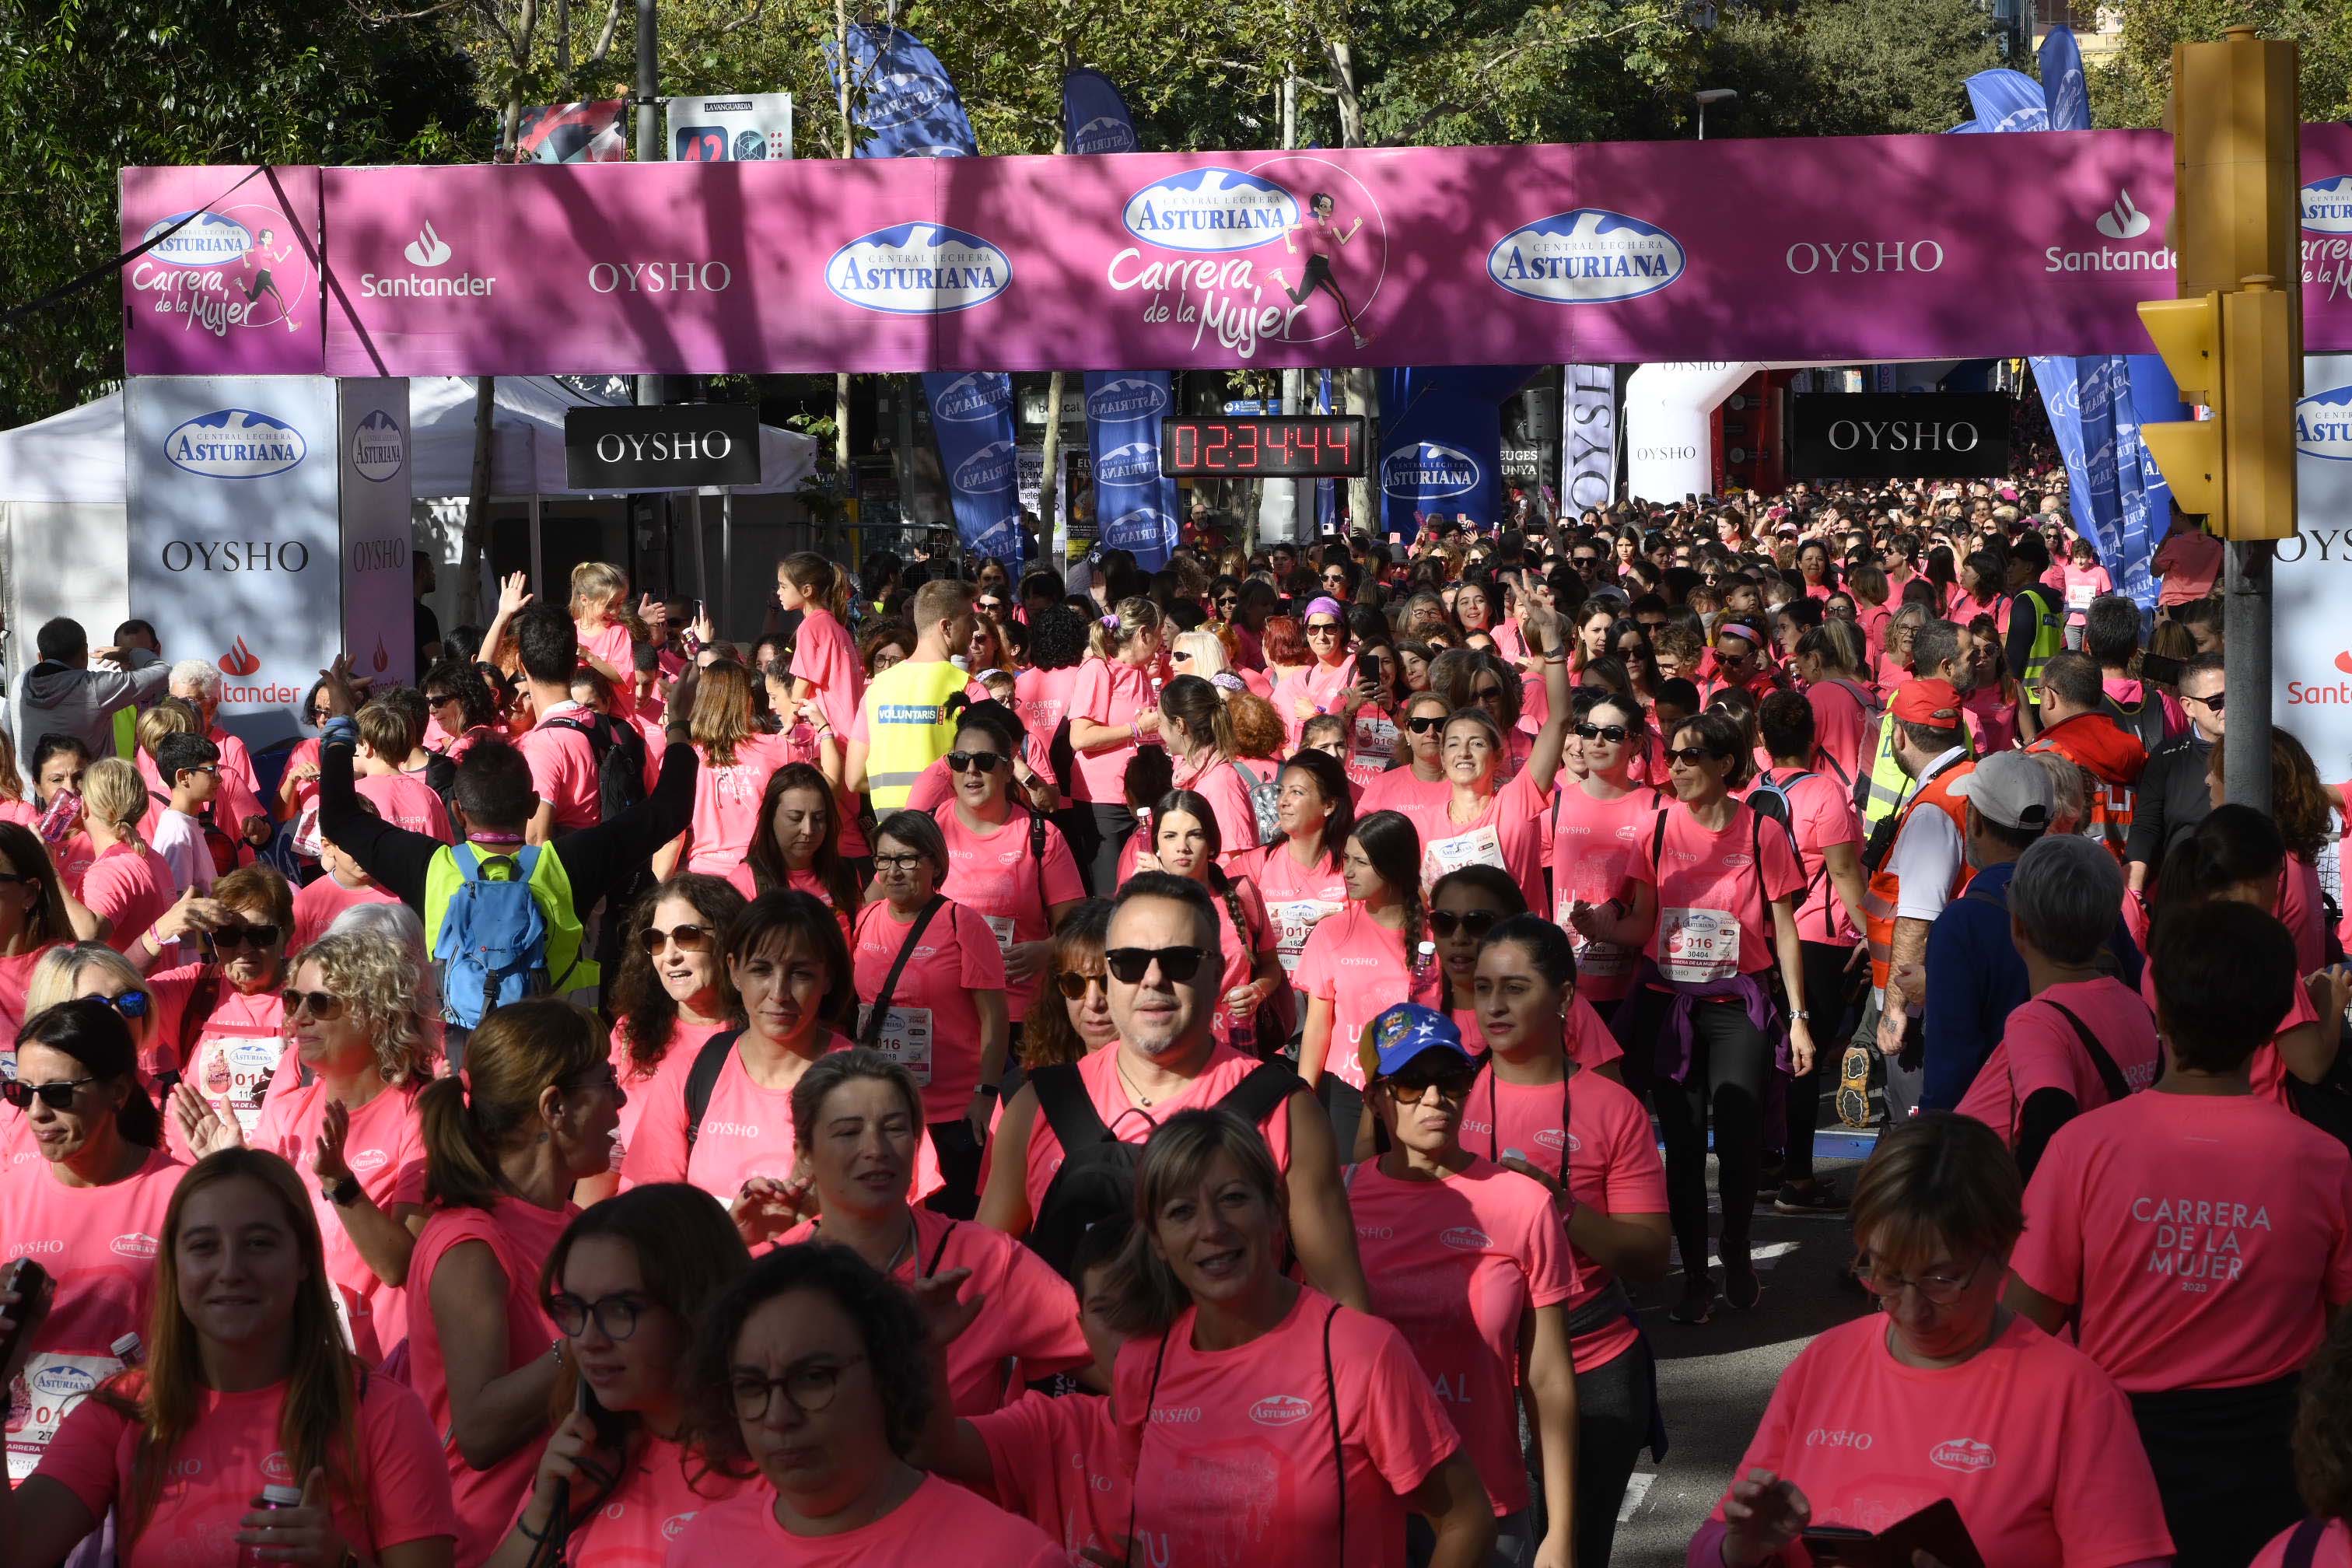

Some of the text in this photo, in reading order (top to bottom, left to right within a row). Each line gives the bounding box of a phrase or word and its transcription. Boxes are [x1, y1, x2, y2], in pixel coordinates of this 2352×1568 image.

[1225, 195, 1281, 205] LECHERA
[1136, 200, 1286, 231] ASTURIANA
[1533, 240, 1664, 252] CENTRAL LECHERA
[869, 253, 992, 263] CENTRAL LECHERA
[1502, 245, 1671, 281] ASTURIANA
[1786, 240, 1944, 275] OYSHO
[2045, 247, 2177, 272] Santande
[132, 261, 223, 292] Carrera
[588, 261, 731, 292] OYSHO
[839, 257, 998, 291] ASTURIANA
[1107, 247, 1255, 291] Carrera
[2318, 261, 2332, 284] la
[361, 273, 496, 298] Santander
[155, 289, 259, 337] de la Mujer
[1143, 285, 1308, 359] de la Mujer
[1038, 401, 1081, 414] b.cat
[197, 432, 292, 441] CENTRAL LECHERA
[597, 429, 731, 464] OYSHO
[1174, 425, 1349, 467] 02:34:44
[1570, 363, 1612, 511] OYSH
[1828, 420, 1979, 452] OYSHO
[176, 435, 296, 461] ASTURIANA
[355, 436, 401, 465] ASTURIANA
[1637, 446, 1696, 461] OYSHO
[1019, 471, 1032, 479] que
[1384, 469, 1472, 487] ASTURIANA
[162, 541, 309, 572] OYSHO
[353, 537, 405, 573] OYSHO
[218, 682, 301, 703] tander
[880, 709, 936, 720] VOLUNTARIS
[1025, 700, 1062, 710] CARRERA
[1397, 803, 1425, 812] OYSHO
[1558, 826, 1591, 835] OYSHO
[1265, 888, 1294, 898] OYSHO
[1686, 937, 1713, 949] 016
[1341, 957, 1379, 967] OYSHO
[876, 1037, 901, 1050] 016
[234, 1052, 272, 1061] ASTURIANA
[2122, 1059, 2156, 1086] ARRE
[708, 1121, 761, 1139] OYSHO
[1461, 1118, 1493, 1136] SHO
[2132, 1197, 2272, 1231] CARRERA
[9, 1238, 64, 1258] OYSHO
[114, 1237, 157, 1254] ASTURIAN
[2157, 1223, 2242, 1255] DE LA
[2147, 1251, 2243, 1281] MUJER
[2181, 1280, 2207, 1293] 2023
[37, 1375, 91, 1390] ASTURIANA
[1434, 1370, 1472, 1403] AL
[1251, 1405, 1307, 1420] ASTURIANA
[6, 1442, 40, 1453] ARRERA
[1805, 1428, 1873, 1451] OYSHO
[1934, 1448, 1992, 1465] ASTURIANA
